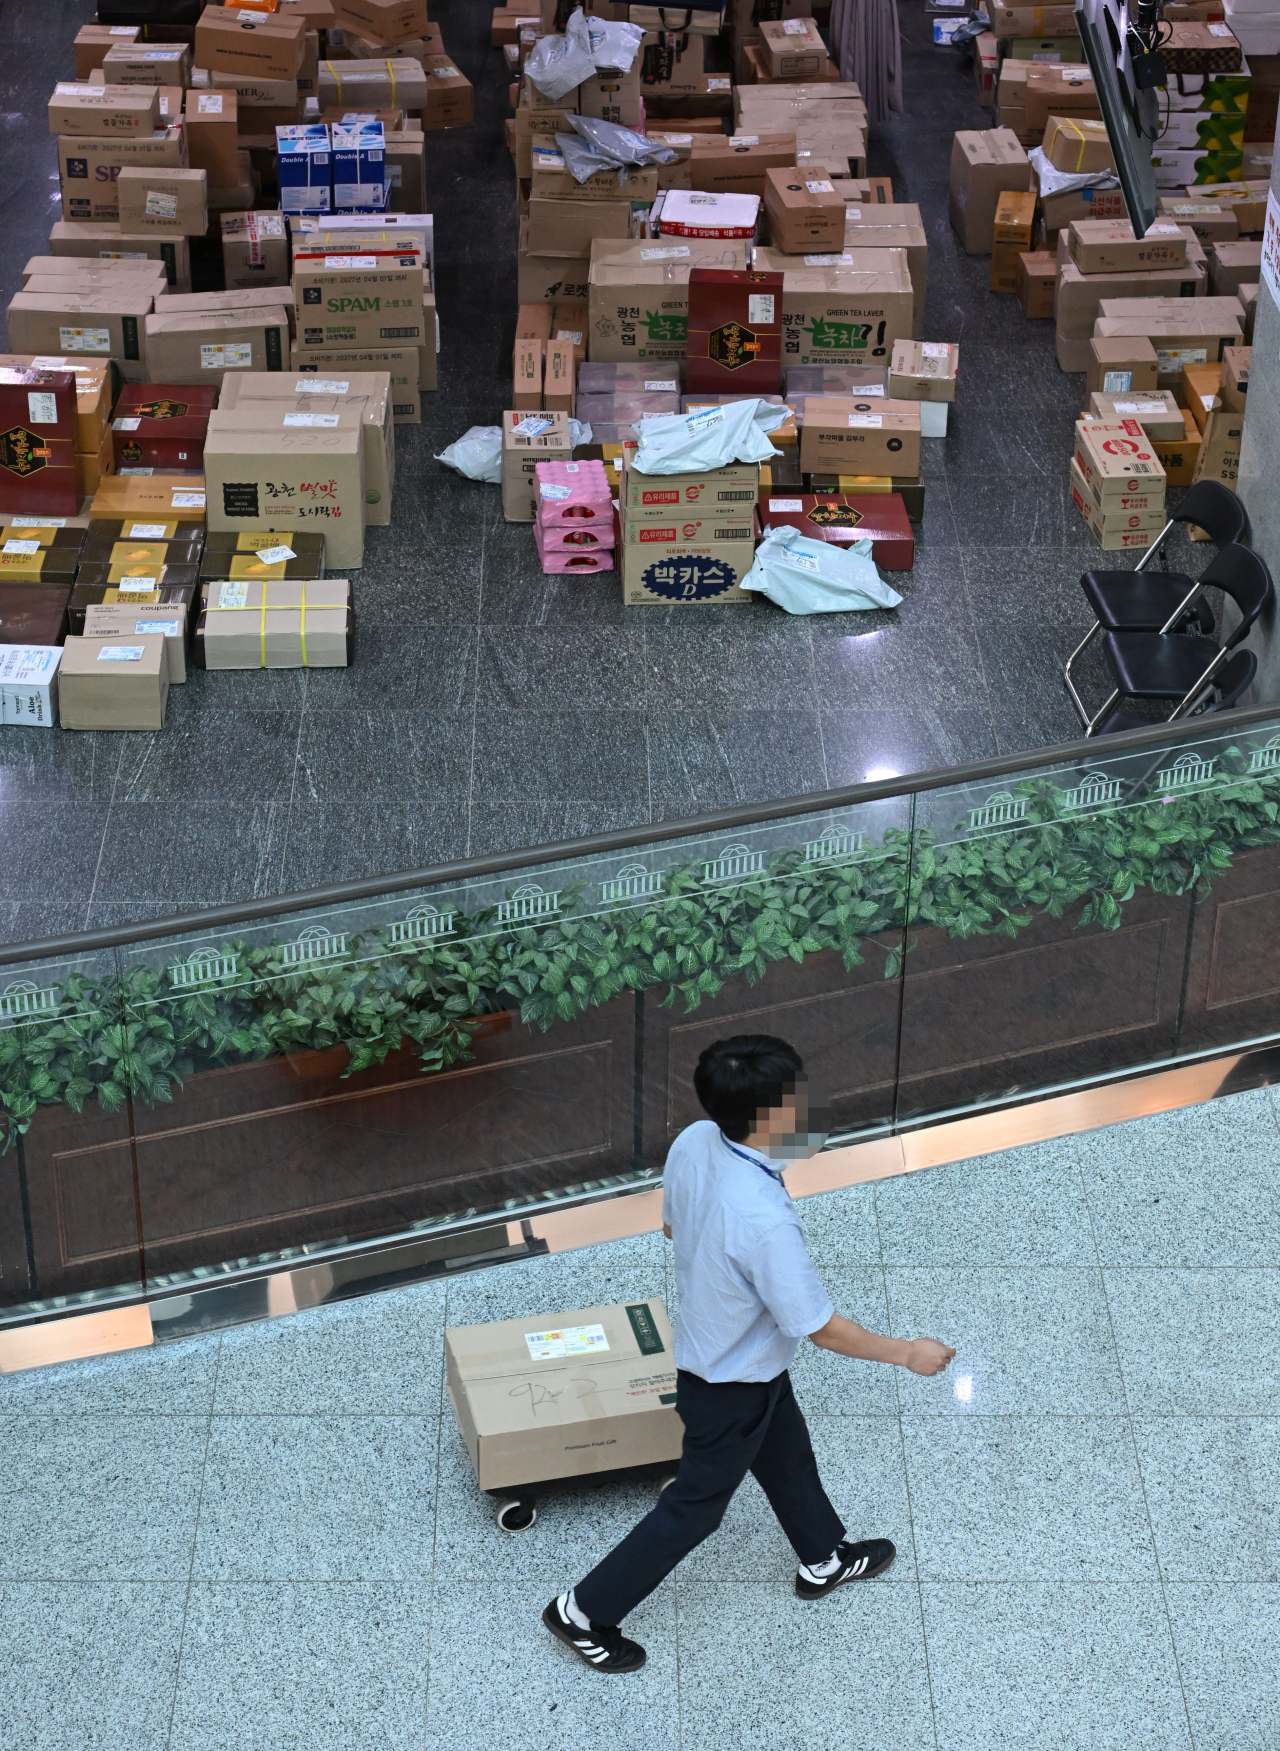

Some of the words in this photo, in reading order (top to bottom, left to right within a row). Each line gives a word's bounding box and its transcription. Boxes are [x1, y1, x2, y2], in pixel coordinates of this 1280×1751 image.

[95, 165, 122, 182] SP
[1089, 196, 1121, 206] 신선식품
[1089, 207, 1121, 216] 취급주의
[698, 228, 719, 237] 당일배송
[340, 276, 360, 284] 2027년
[563, 284, 588, 297] 로켓
[327, 297, 381, 313] SPAM
[385, 299, 400, 308] 스팸
[616, 307, 640, 318] 광천
[827, 309, 848, 317] GREEN
[850, 309, 862, 317] TEA
[863, 309, 884, 317] LAVER
[782, 313, 805, 326] 광천
[620, 320, 637, 332] 농
[620, 333, 636, 345] 협
[785, 327, 801, 339] 농
[817, 324, 861, 348] 녹차
[785, 341, 800, 353] 협
[281, 434, 341, 448] 520
[818, 433, 844, 442] 부각마을
[846, 435, 865, 443] 김부각
[1221, 470, 1238, 479] SS
[265, 482, 297, 498] 광천
[300, 478, 338, 500] 별맛
[652, 493, 677, 501] 유리제품
[298, 506, 342, 518] 도시락김
[649, 530, 673, 538] 유리제품
[654, 566, 725, 585] 박카스
[682, 583, 697, 596] D
[564, 1442, 591, 1451] Premium
[591, 1440, 605, 1449] Fruit
[605, 1439, 617, 1447] Gift
